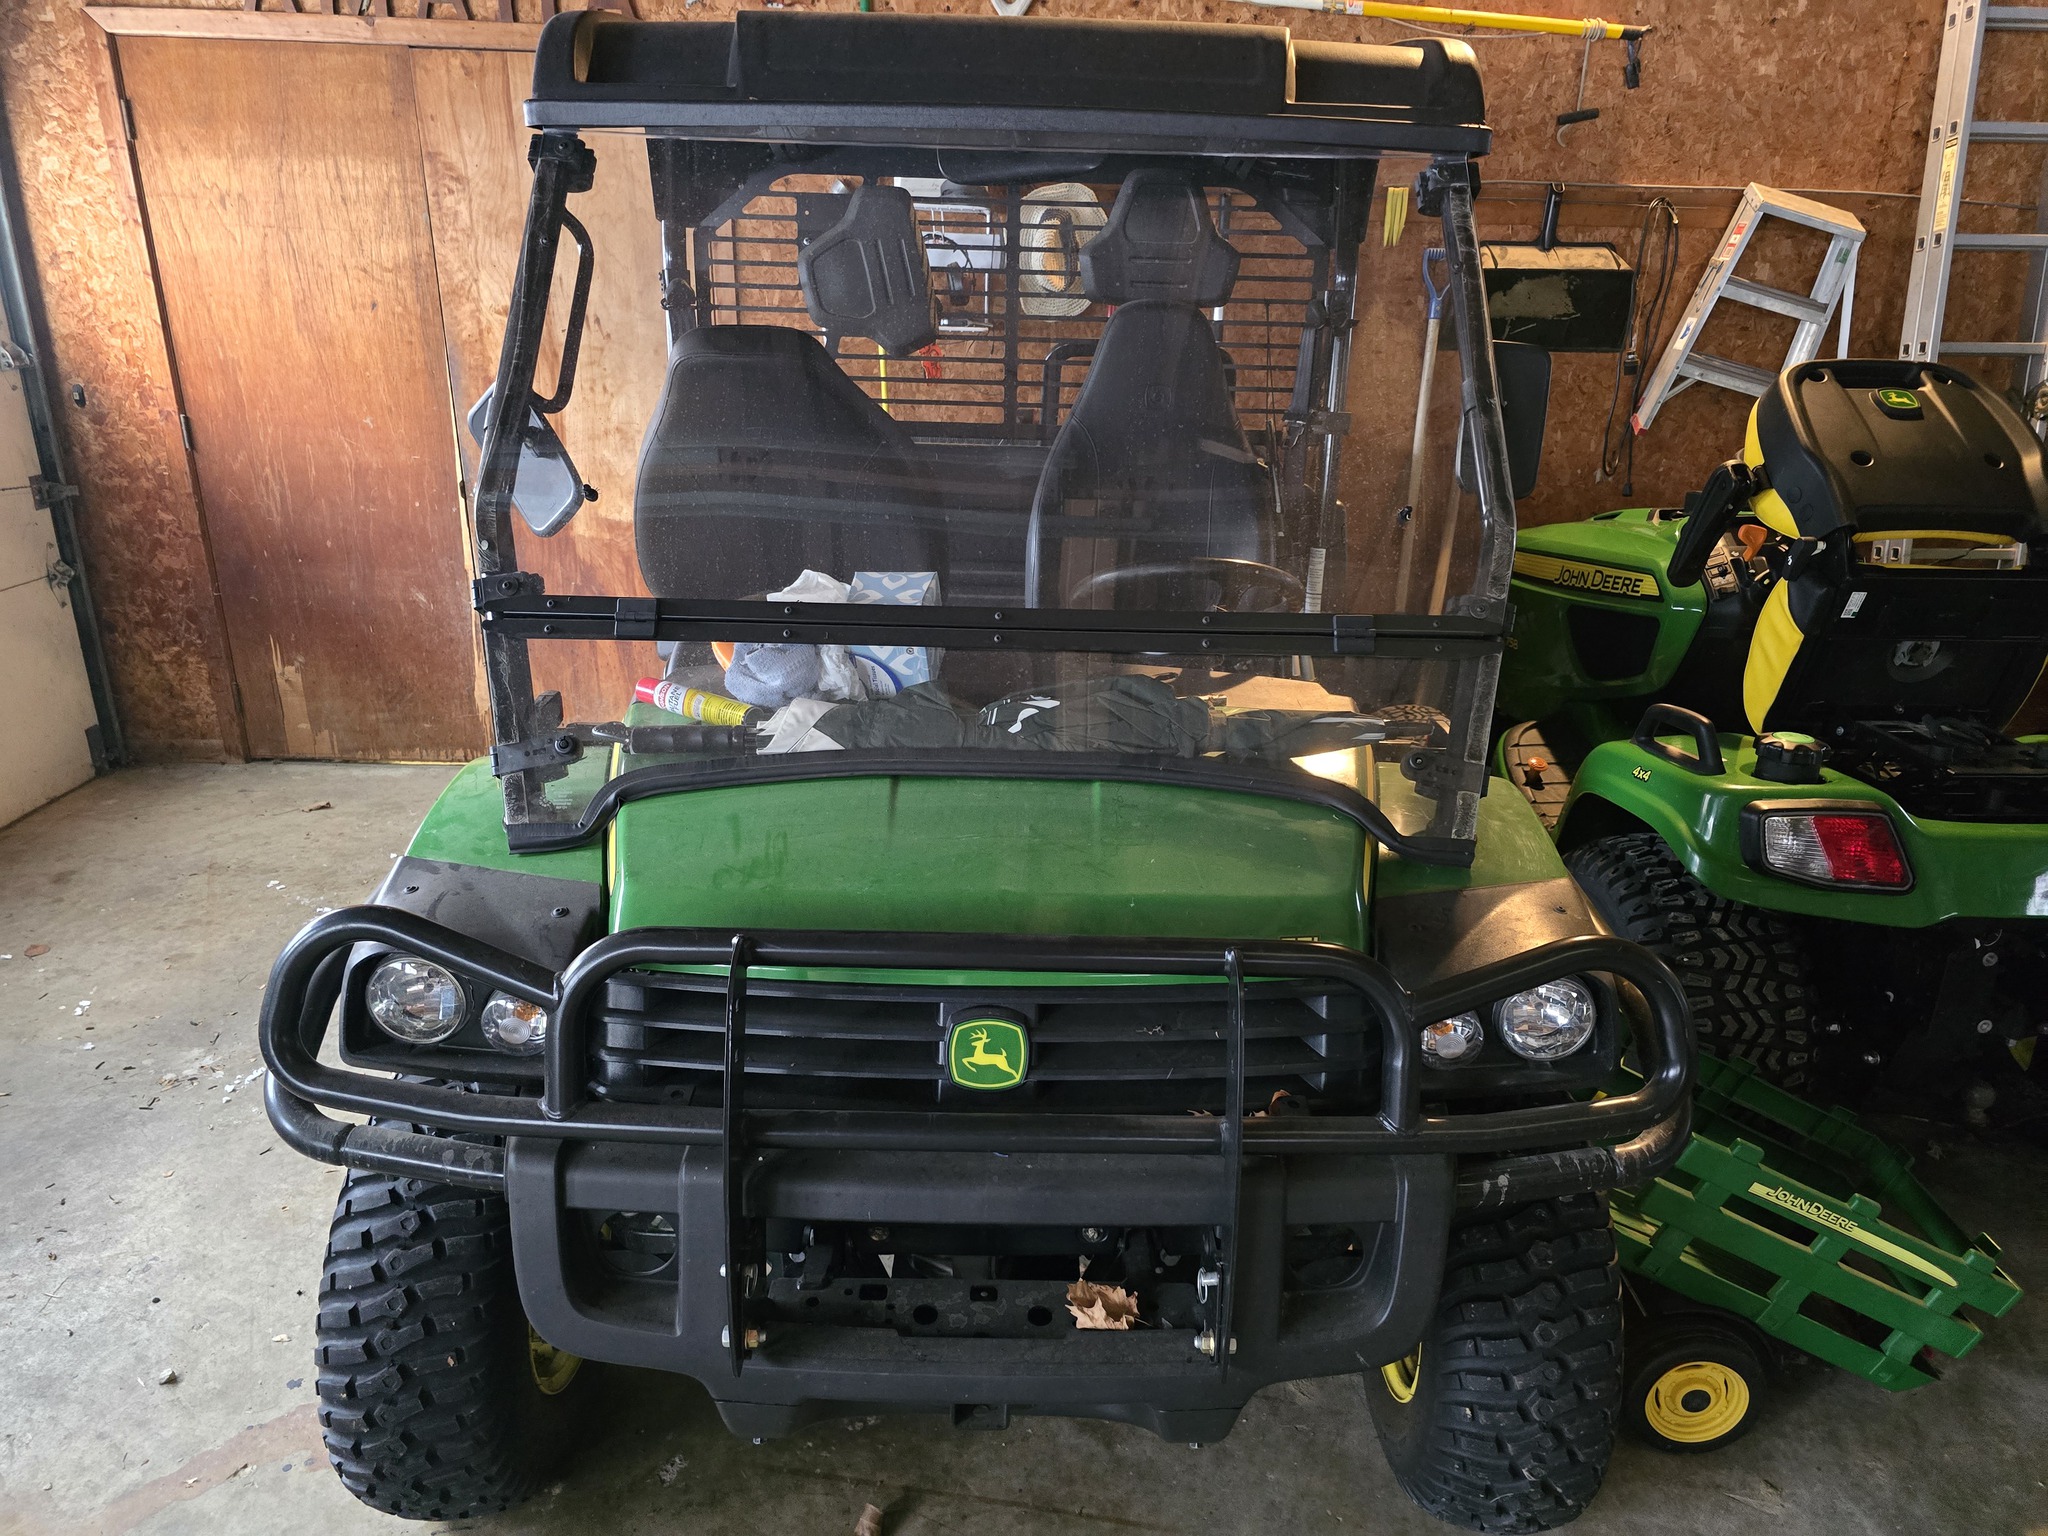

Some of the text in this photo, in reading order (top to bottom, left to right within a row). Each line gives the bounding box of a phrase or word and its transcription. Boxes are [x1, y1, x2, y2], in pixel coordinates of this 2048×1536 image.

[1553, 564, 1644, 594] JOHN DEERE
[674, 692, 683, 712] FUEL
[1632, 766, 1652, 782] 4x4
[1767, 1186, 1858, 1231] JOHN DEERE
